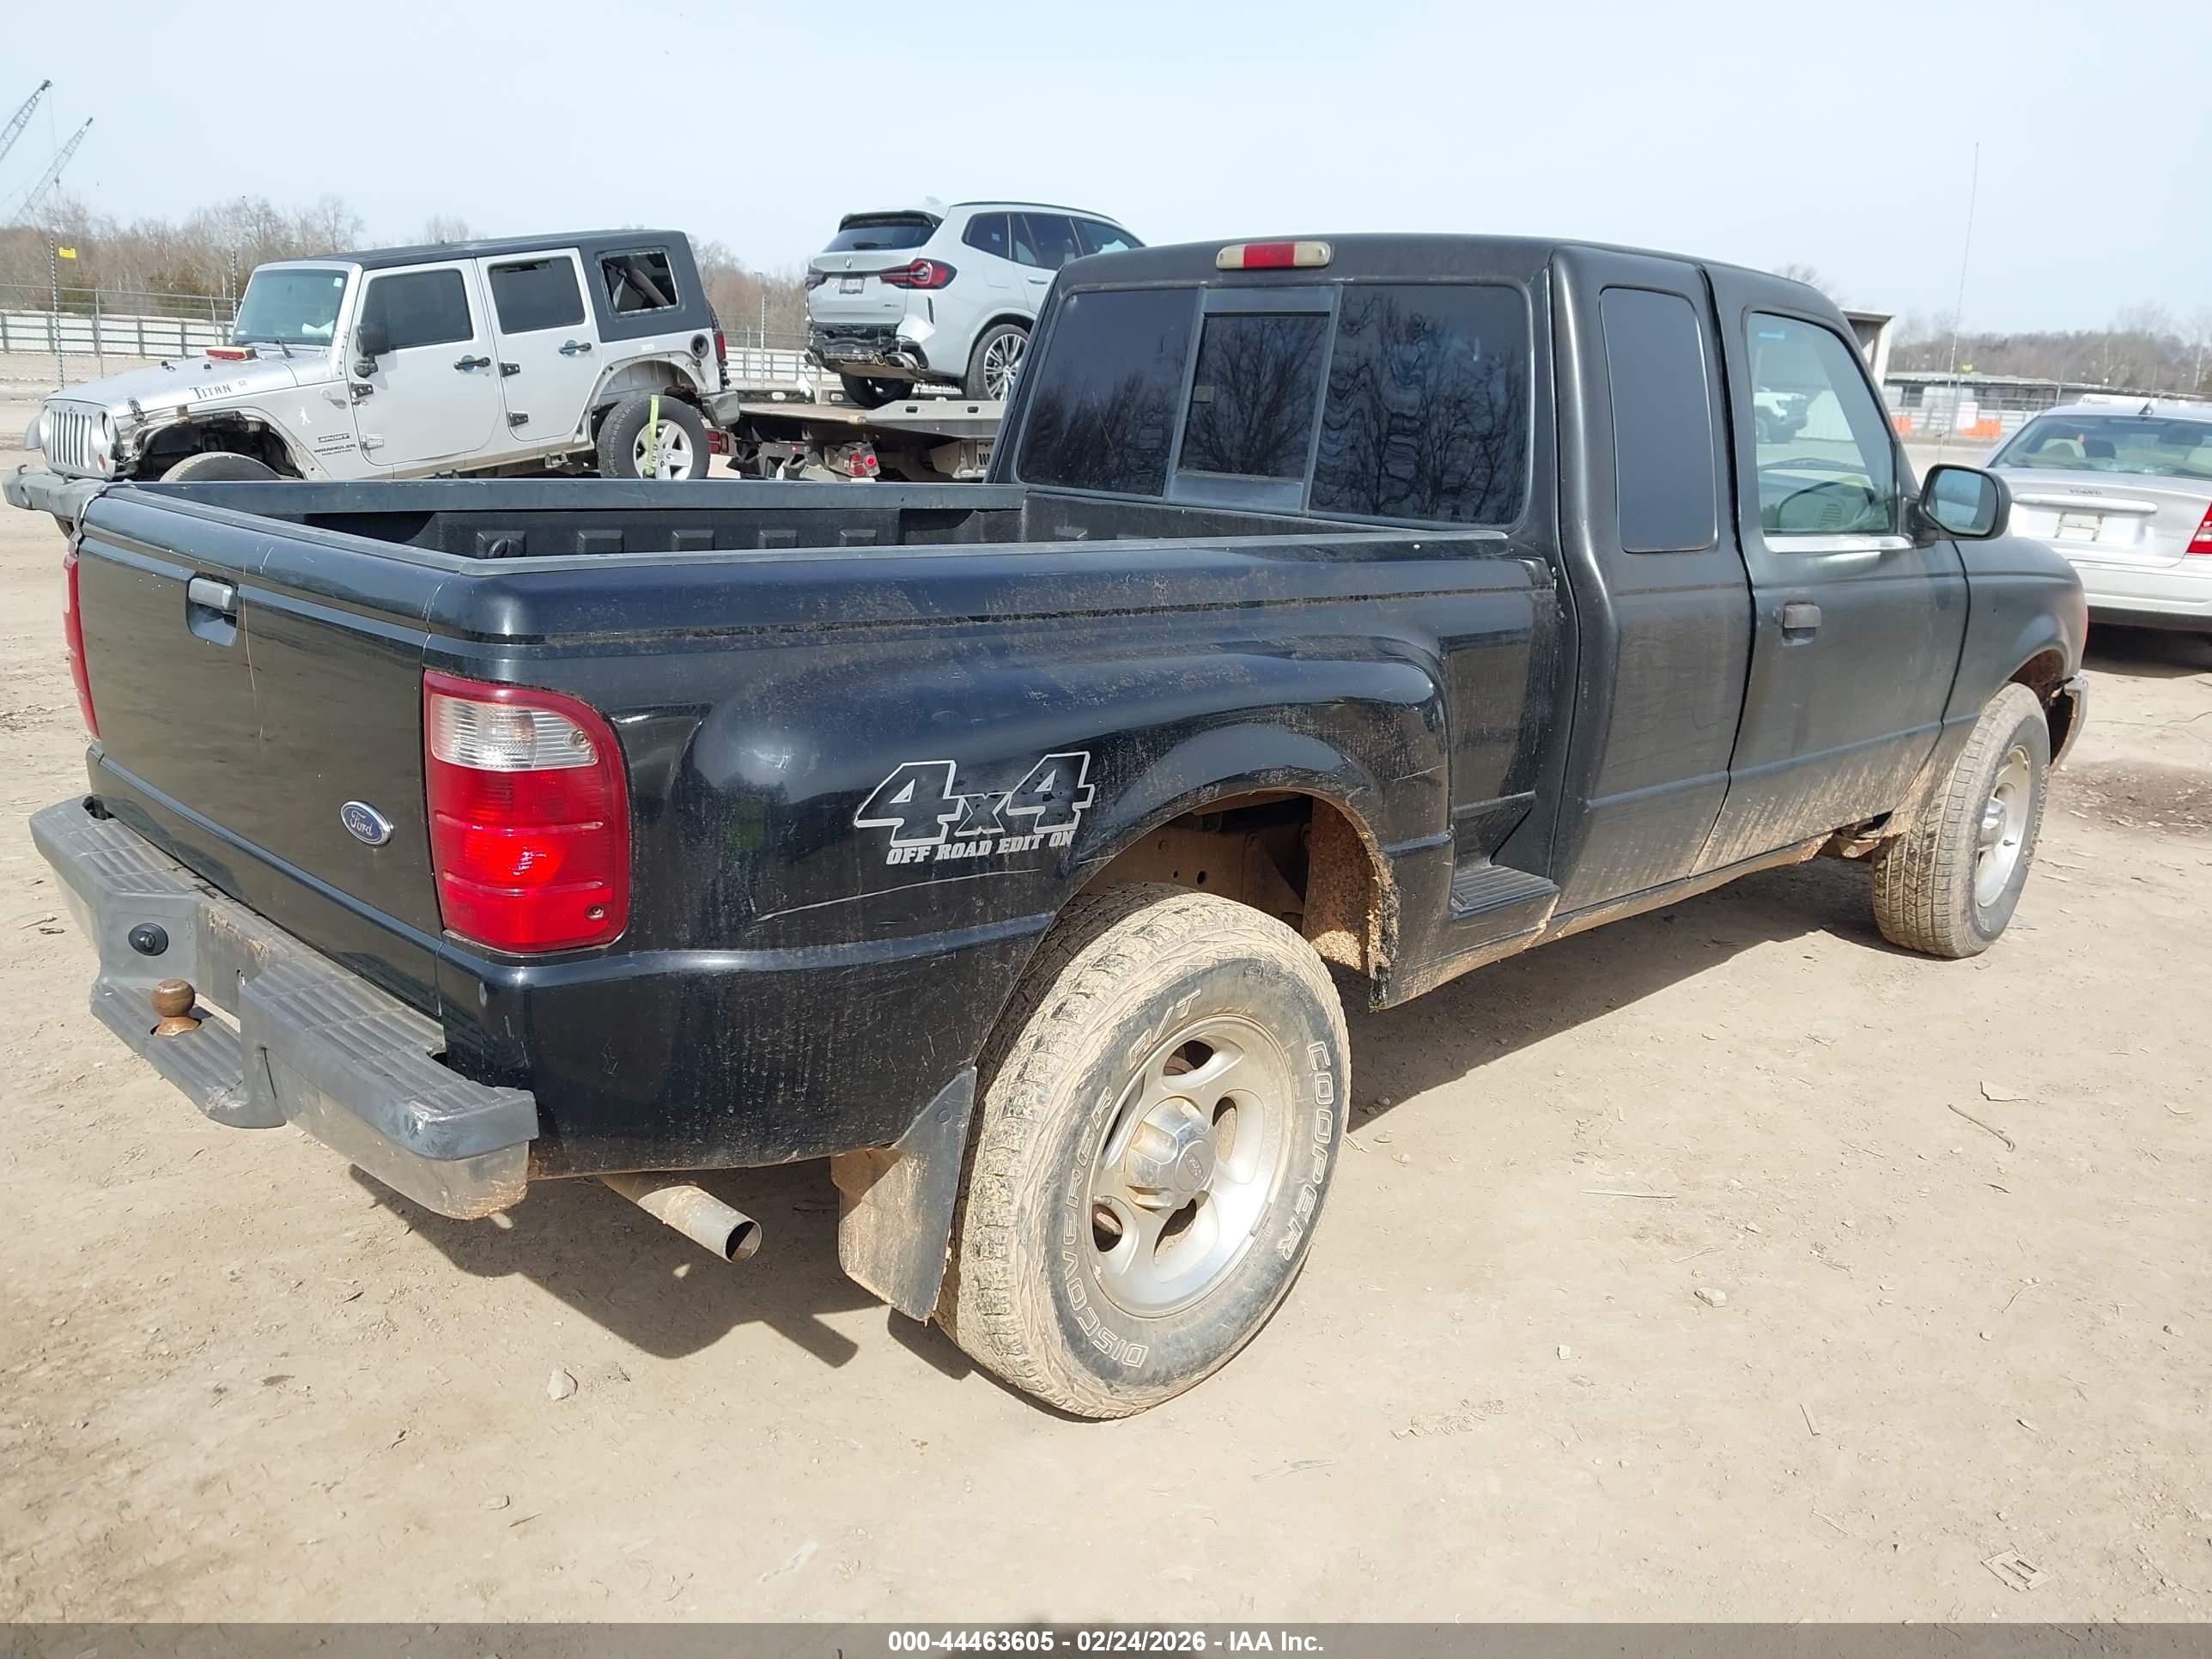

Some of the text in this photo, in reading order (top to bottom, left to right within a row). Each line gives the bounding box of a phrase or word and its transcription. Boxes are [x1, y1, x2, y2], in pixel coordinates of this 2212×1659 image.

[188, 384, 232, 399] TITAN
[349, 810, 374, 836] Ford
[854, 750, 1096, 848] 4x4
[885, 844, 932, 866] OFF
[934, 839, 994, 861] ROAD
[1060, 988, 1201, 1370] DISCOVERER A/T
[1276, 1040, 1333, 1262] COOPER
